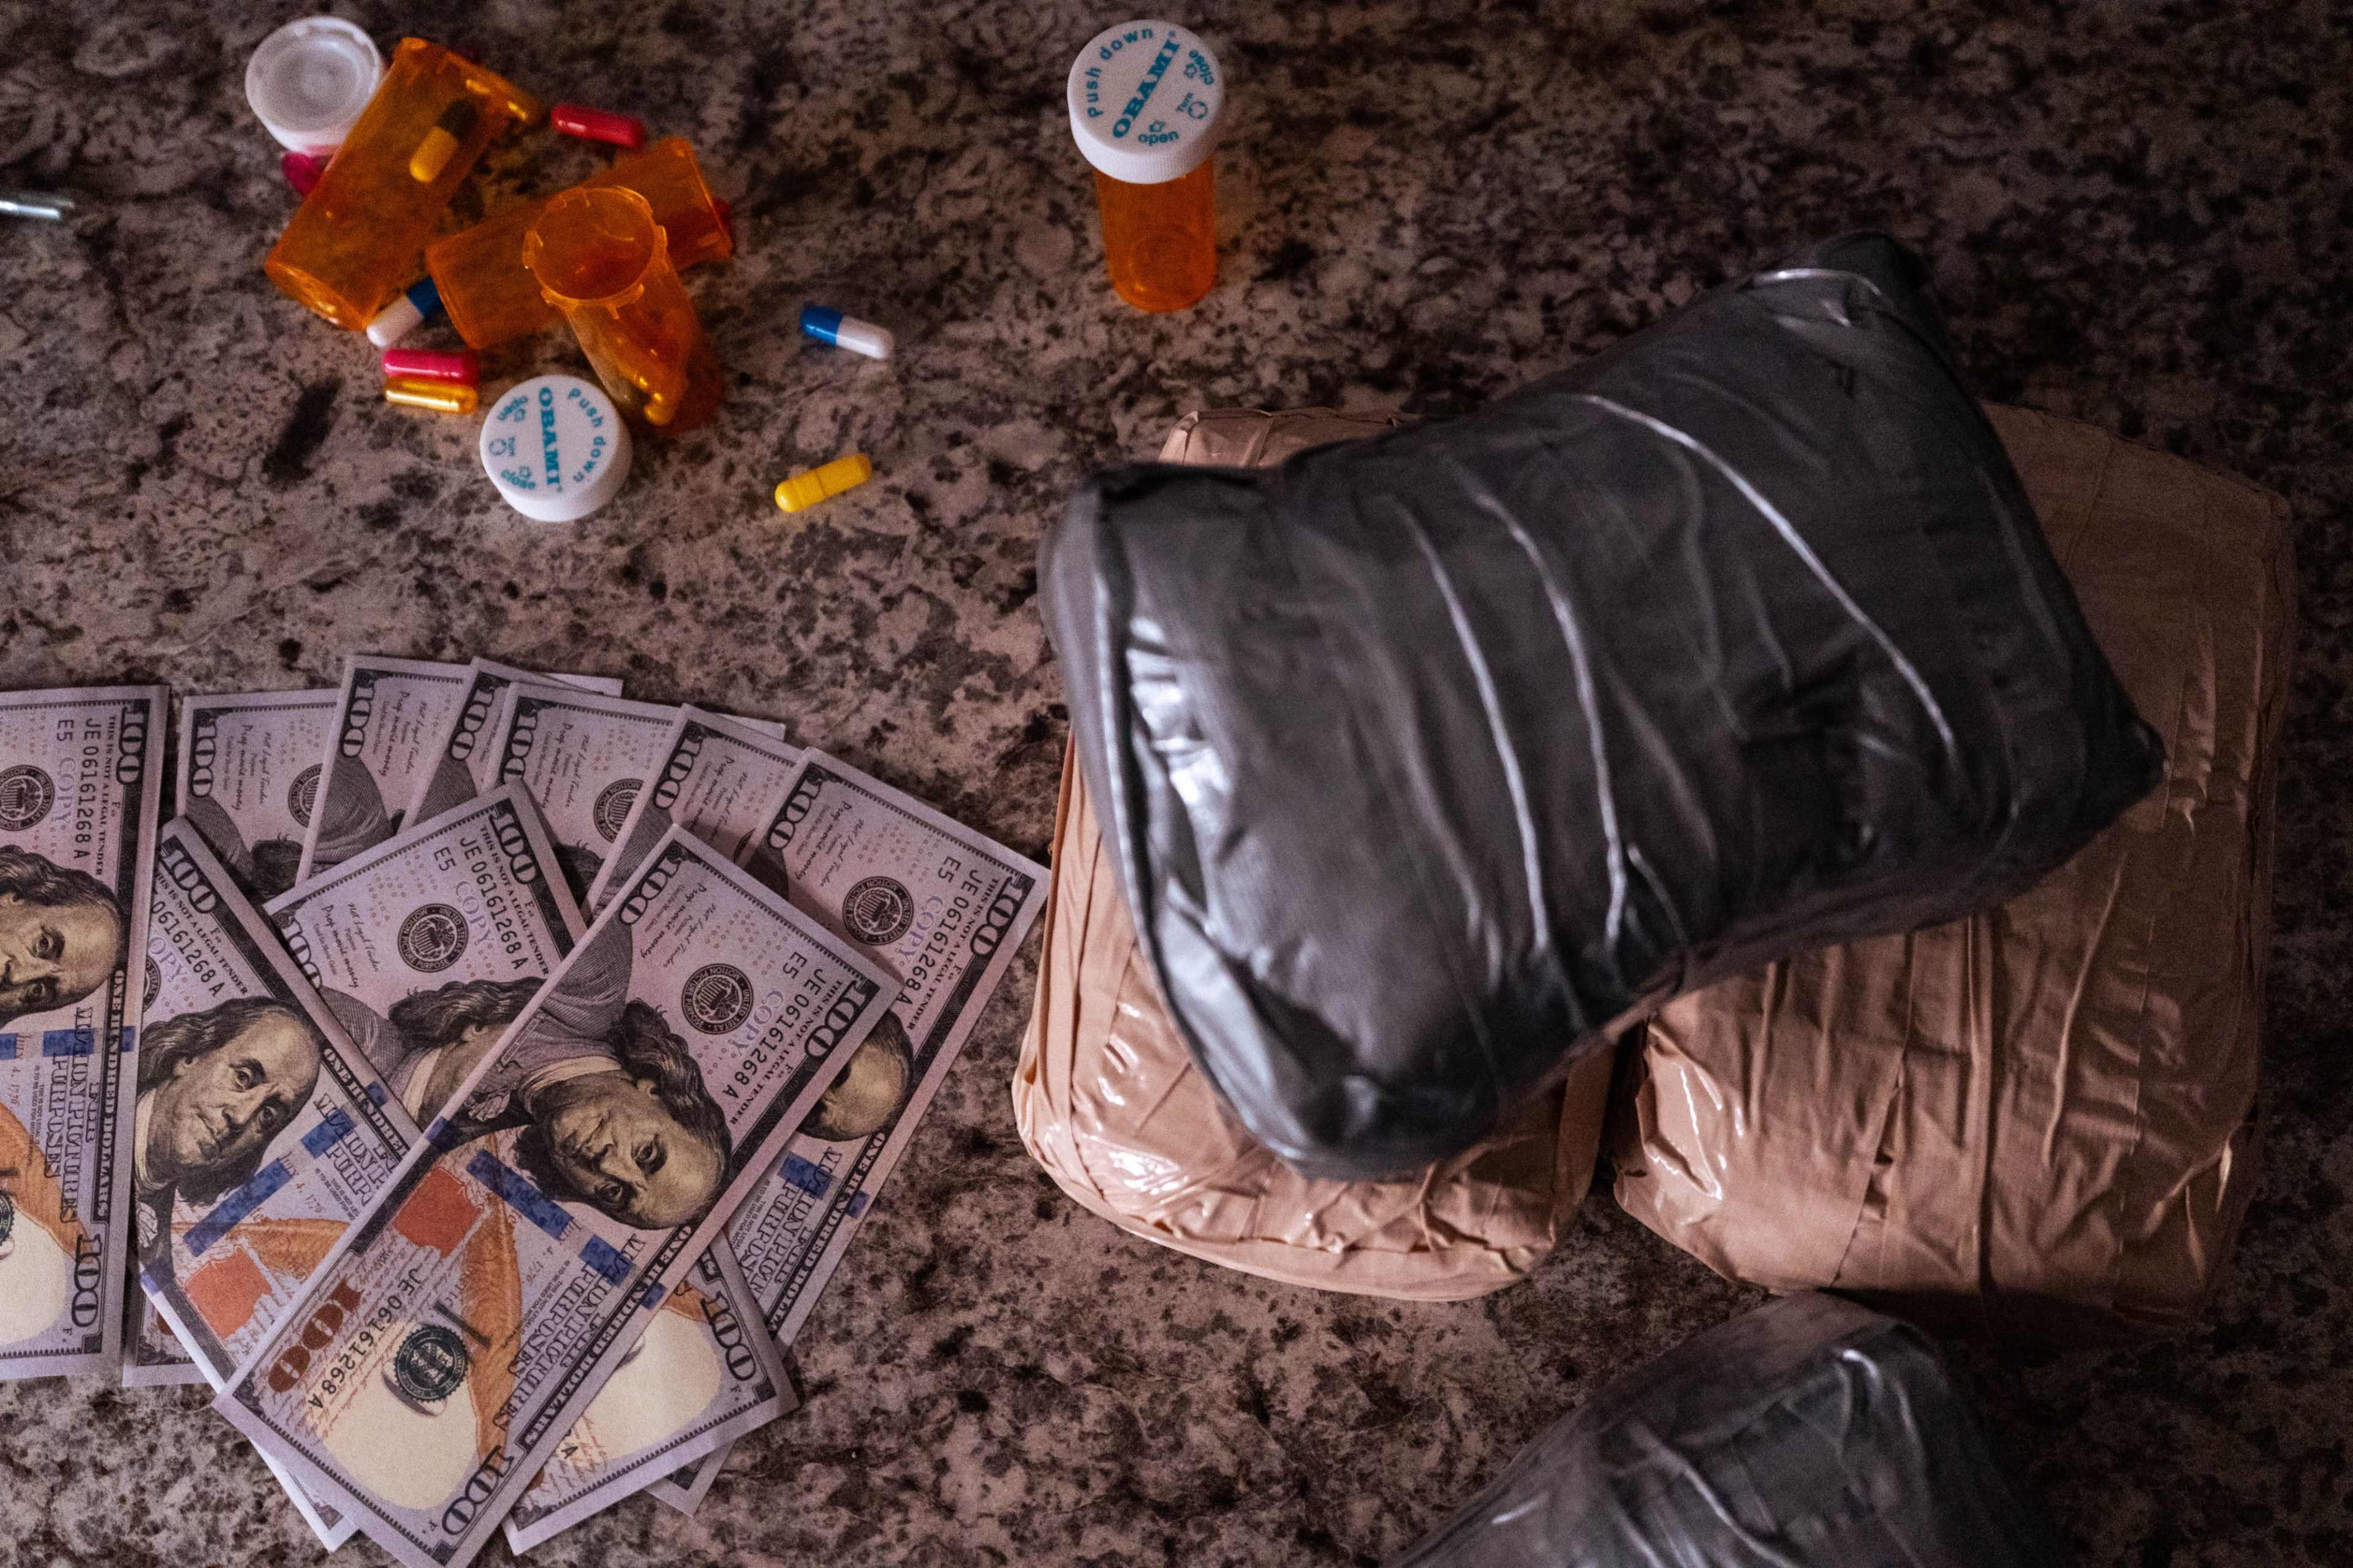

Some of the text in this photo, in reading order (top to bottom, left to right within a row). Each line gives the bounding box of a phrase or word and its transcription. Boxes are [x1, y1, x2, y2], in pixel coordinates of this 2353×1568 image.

[1087, 27, 1154, 118] Push down
[1138, 129, 1179, 146] open
[496, 395, 528, 422] open
[568, 388, 607, 482] Push down
[56, 719, 74, 741] E5
[105, 743, 113, 755] IS
[106, 715, 115, 742] THIS
[115, 706, 145, 786] 100
[338, 681, 376, 760] 100
[445, 683, 496, 765] 100
[499, 710, 539, 789] 100
[53, 756, 76, 825] COPY
[73, 718, 101, 860] JE 06161268 A
[102, 757, 112, 780] NOT
[188, 721, 220, 800] 100
[651, 732, 703, 815] 100
[99, 792, 108, 825] LEGAL
[487, 806, 539, 888] 100
[765, 773, 824, 854] 100
[814, 823, 835, 851] movie
[828, 798, 852, 825] Prop
[94, 829, 105, 876] TENDER
[157, 844, 221, 918] 100
[433, 846, 456, 873] E5
[613, 849, 683, 931] 100
[792, 848, 818, 882] money
[819, 817, 866, 890] Not Legal Tender
[936, 855, 961, 883] E5
[452, 878, 494, 947] COPY
[458, 834, 528, 969] JE 06161268 A
[479, 825, 550, 976] THIS IS NOT A LEGAL TENDER
[665, 904, 688, 931] movie
[681, 916, 705, 944] Legal
[683, 881, 708, 907] Prop
[700, 901, 718, 921] Not
[895, 893, 946, 964] COPY
[966, 875, 1028, 960] 100
[148, 898, 225, 997] 06161268 A
[167, 888, 249, 996] IS NOT A LEGAL TENDER
[281, 918, 320, 990] 100
[320, 904, 338, 929] Prop
[333, 928, 349, 956] movie
[342, 956, 359, 989] money
[347, 901, 381, 973] Not Legal Tender
[637, 926, 666, 961] money
[661, 941, 688, 972] Tender
[780, 950, 808, 979] E5
[895, 868, 985, 1008] JE 06161268 A
[906, 877, 999, 1032] THIS IS NOT A LEGAL TENDER
[722, 966, 830, 1101] JE 06161268 A
[727, 985, 787, 1058] COPY
[728, 977, 843, 1126] THIS IS NOT A LEGAL TENDER
[799, 977, 872, 1064] 100
[96, 969, 124, 1217] ONE HUNDRED DOLLARS
[322, 1046, 352, 1083] ONE
[42, 1053, 70, 1179] PURPOSES
[856, 1130, 887, 1173] ONE
[59, 1099, 85, 1224] PICTURES
[69, 1233, 104, 1328] 100
[396, 1266, 424, 1297] JE
[658, 1222, 694, 1266] ONE
[266, 1278, 363, 1393] 100
[318, 1291, 404, 1398] 06161268
[505, 1260, 599, 1381] PURPOSES
[588, 1262, 663, 1358] HUNDRED
[697, 1289, 761, 1385] 100
[306, 1393, 327, 1411] A
[490, 1314, 583, 1432] PICTURES
[522, 1354, 595, 1447] DOLLARS
[436, 1442, 518, 1540] 100
